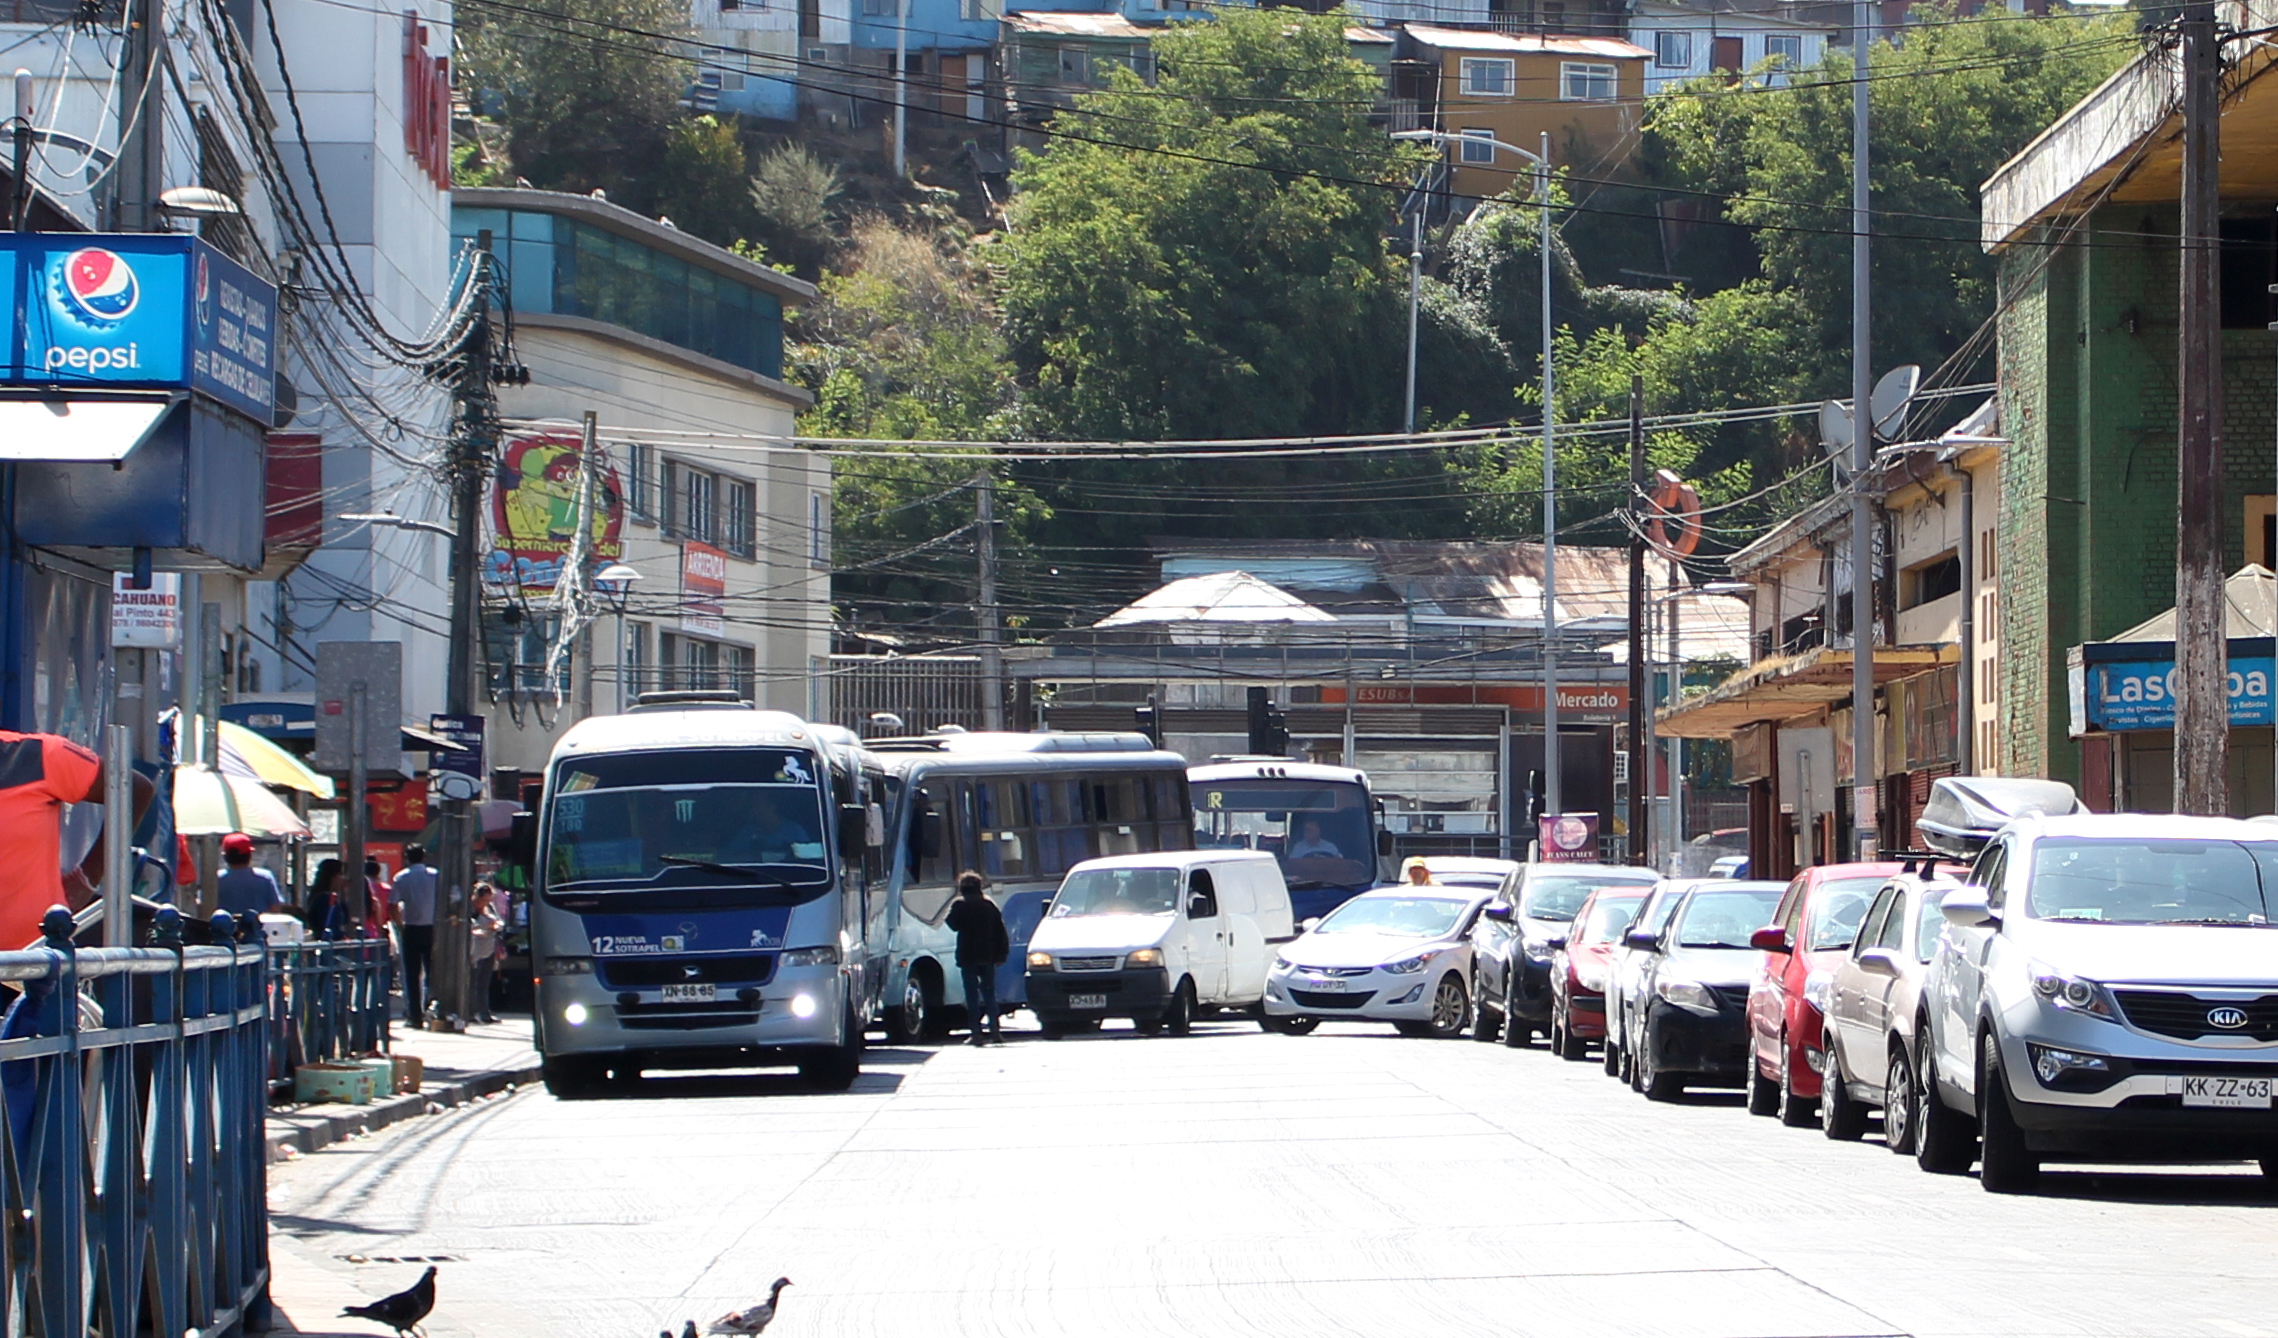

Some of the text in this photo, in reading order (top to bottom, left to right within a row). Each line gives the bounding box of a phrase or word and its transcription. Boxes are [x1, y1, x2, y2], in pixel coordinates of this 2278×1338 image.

[45, 342, 137, 374] pepsi
[599, 543, 620, 556] del
[127, 608, 154, 618] Pinto
[1357, 688, 1396, 701] ESUB
[1556, 691, 1618, 708] Mercado
[592, 936, 613, 953] 12
[615, 936, 646, 944] NUEVA
[615, 944, 660, 952] SOTRAPEL
[2214, 1011, 2242, 1024] KIA
